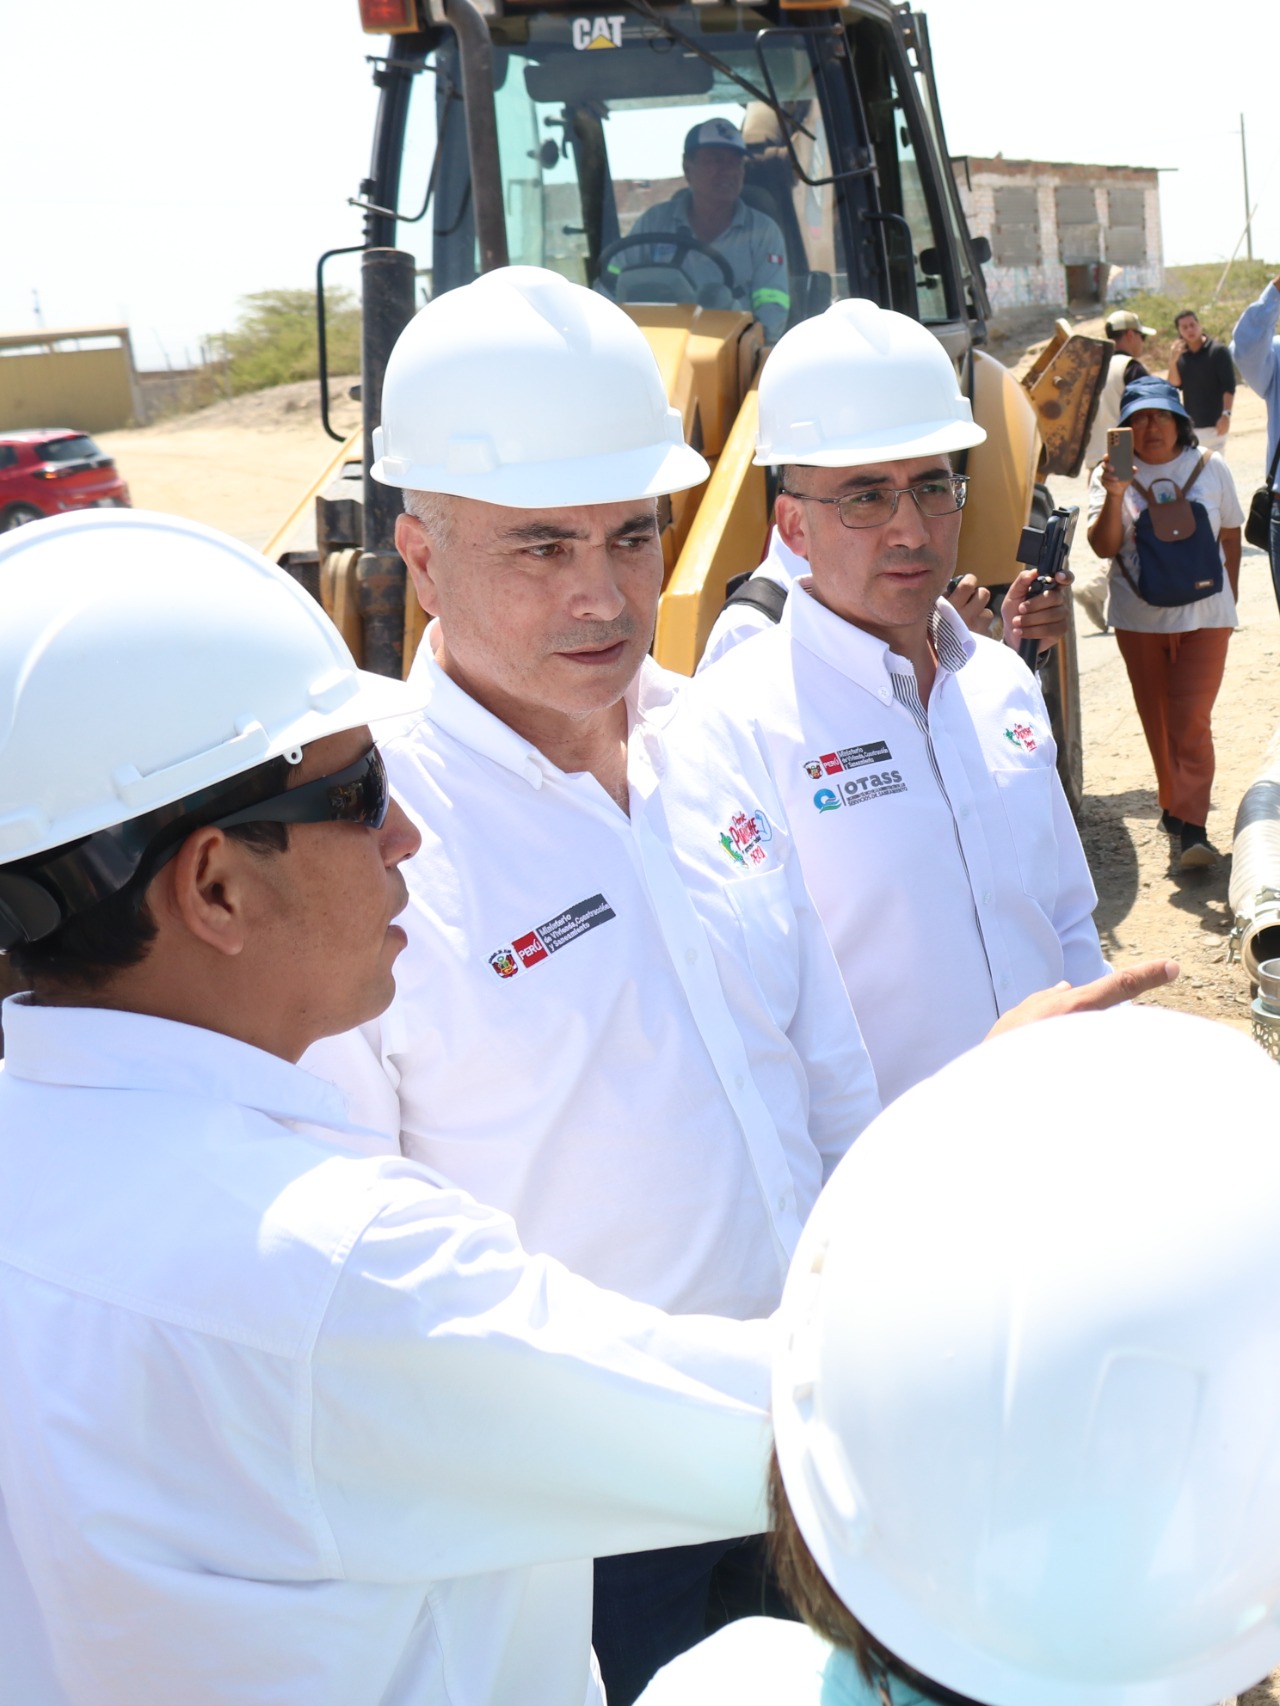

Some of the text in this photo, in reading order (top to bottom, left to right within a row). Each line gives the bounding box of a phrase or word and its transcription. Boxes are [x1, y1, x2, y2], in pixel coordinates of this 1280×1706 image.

[573, 15, 626, 50] CAT
[823, 757, 840, 769] PERÚ
[538, 913, 572, 937] Ministerio
[553, 922, 591, 947] Saneamiento
[518, 938, 543, 960] PERÚ
[543, 935, 552, 944] de
